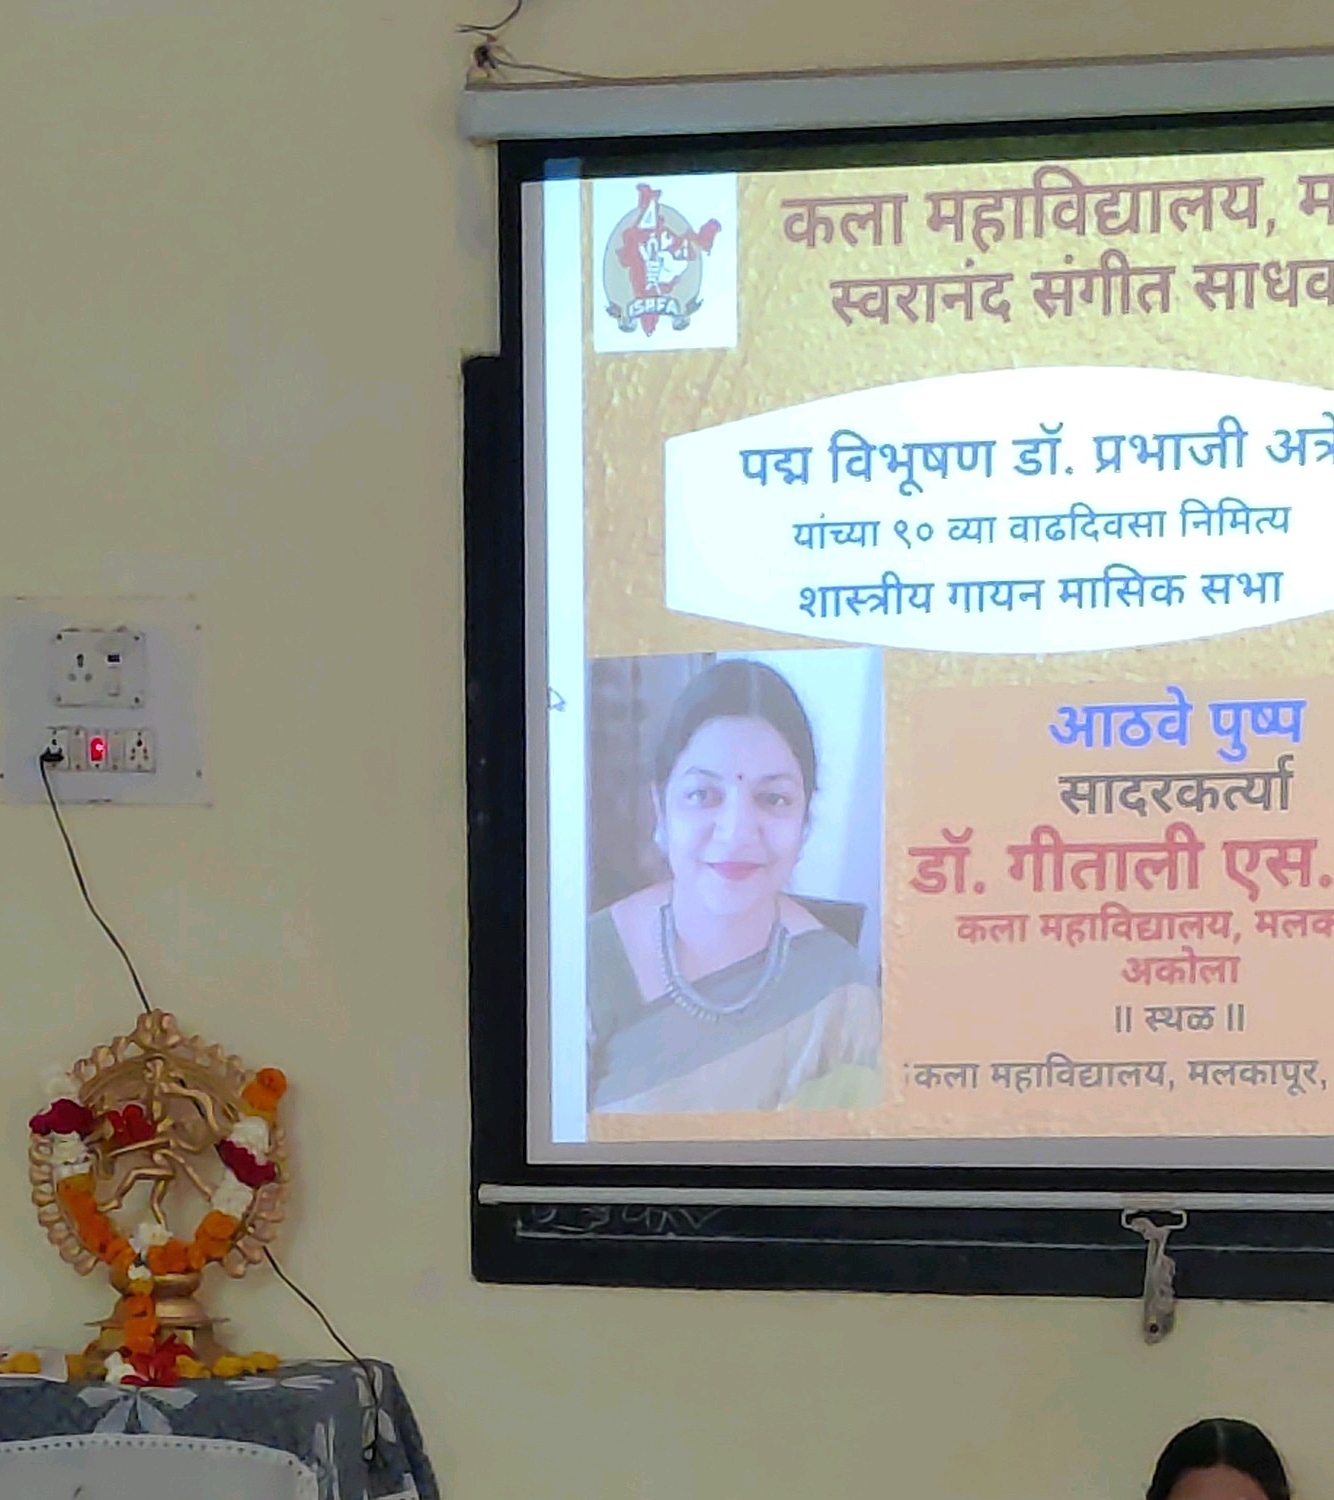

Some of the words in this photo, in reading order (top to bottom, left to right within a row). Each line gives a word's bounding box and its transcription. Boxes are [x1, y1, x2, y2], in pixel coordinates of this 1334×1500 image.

[781, 194, 908, 249] कला
[925, 165, 1276, 254] महाविद्यालय,
[830, 258, 1013, 327] स्वरानंद
[1031, 249, 1175, 319] संगीत
[739, 447, 813, 486] पद्म
[828, 429, 997, 496] विभूषण
[1012, 422, 1074, 476] डॉ.
[1093, 415, 1248, 473] प्रभाजी
[792, 512, 880, 550] यांच्या
[893, 519, 934, 550] ९०
[947, 516, 997, 544] व्या
[1008, 501, 1166, 542] वाढदिवसा
[1180, 496, 1292, 537] निमित्य
[799, 570, 935, 618] शास्त्रीय
[947, 579, 1045, 613] गायन
[1058, 563, 1187, 609] मासिक
[1201, 572, 1284, 605] सभा
[1048, 685, 1193, 749] आठवे
[1208, 698, 1305, 763] पुष्प
[1058, 753, 1295, 817] सादरकर्त्या
[908, 827, 986, 894] डॉ.
[1007, 822, 1205, 892] गीताली
[1222, 838, 1333, 901] एस.
[956, 913, 1029, 944] कला
[1039, 902, 1242, 949] महाविद्यालय,
[1120, 946, 1241, 985] अकोला
[1144, 1005, 1215, 1032] स्थळ
[990, 1052, 1174, 1092] महाविद्यालय,
[1187, 1058, 1327, 1096] मलकापूर,
